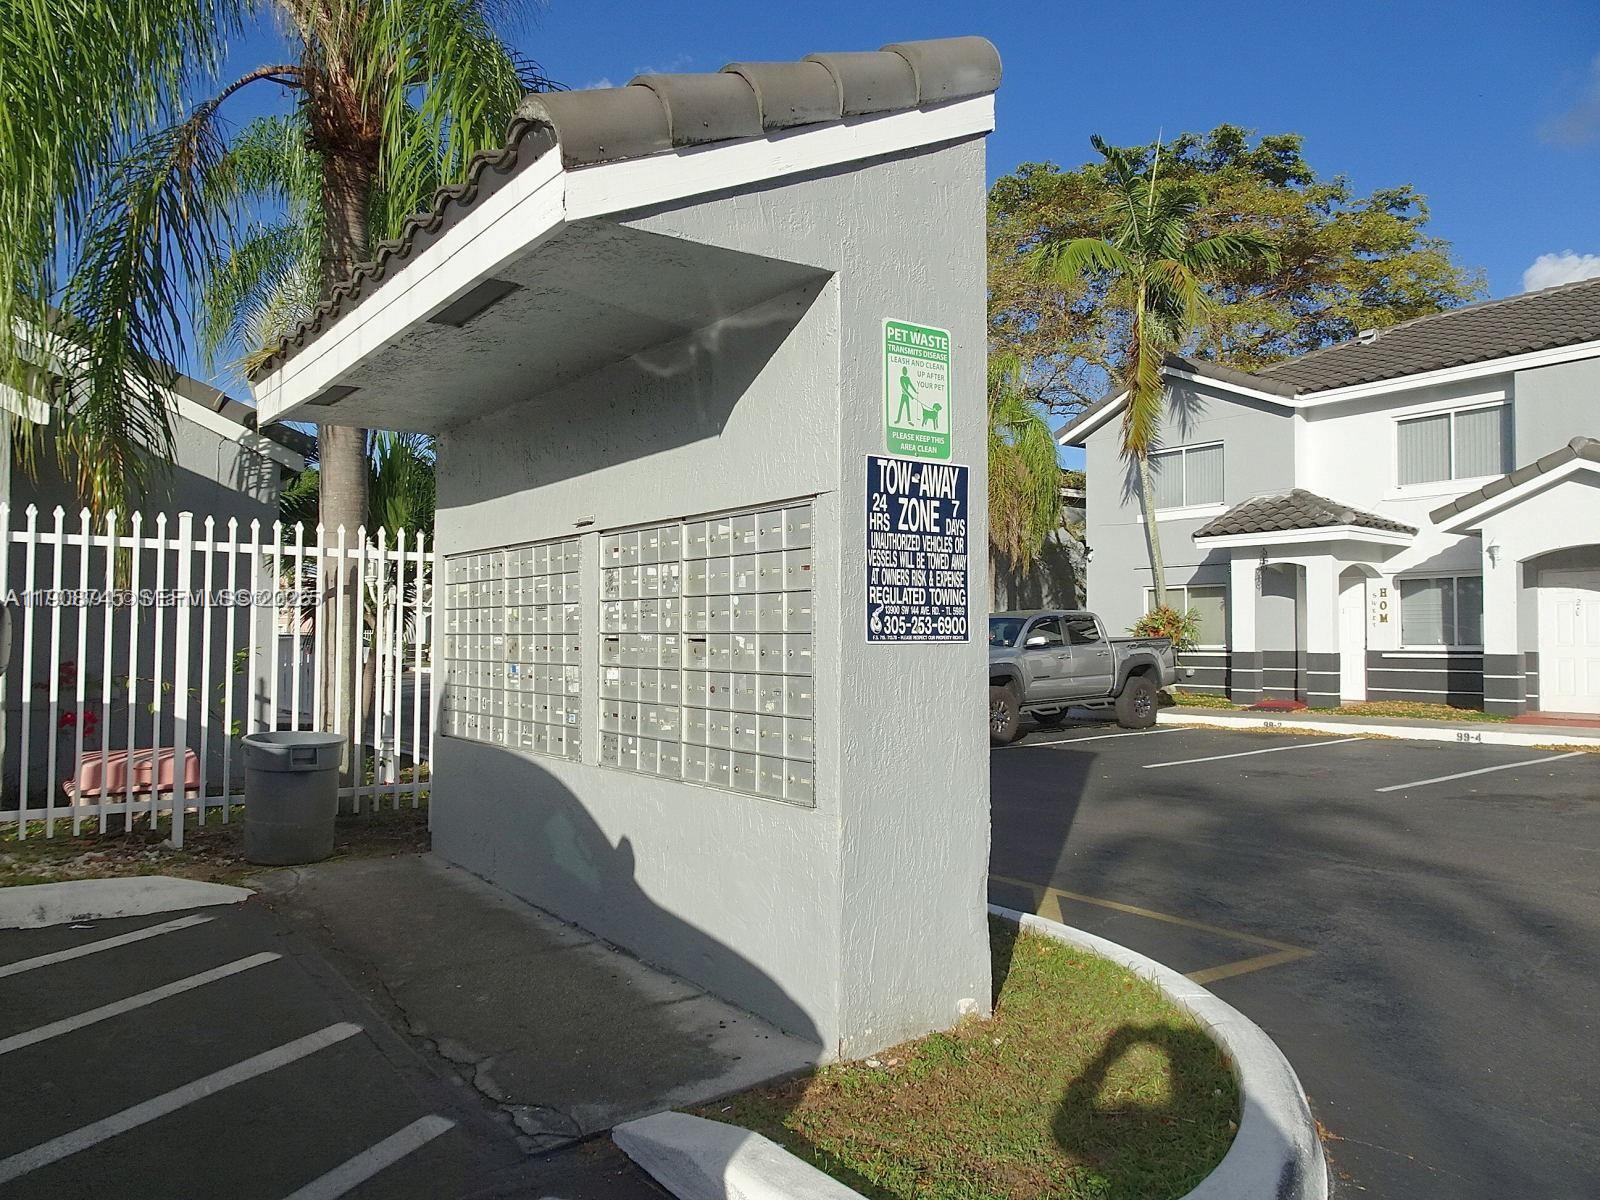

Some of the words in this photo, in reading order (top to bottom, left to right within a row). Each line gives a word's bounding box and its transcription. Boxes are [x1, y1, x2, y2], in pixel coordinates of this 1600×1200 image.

[887, 327, 908, 341] PET
[910, 331, 948, 349] WASTE
[888, 344, 922, 357] TRANSMITS
[924, 351, 948, 361] DISEASE
[890, 356, 910, 366] LEASH
[911, 359, 925, 368] AND
[926, 362, 945, 371] CLEAN
[916, 380, 934, 389] YOUR
[926, 372, 945, 381] AFTER
[892, 431, 915, 441] PLEASE
[916, 435, 931, 443] KEEP
[931, 436, 945, 444] THIS
[900, 443, 916, 452] AREA
[917, 445, 937, 454] CLEAN
[877, 458, 959, 500] TOW-AWAY
[872, 492, 888, 512] 24
[951, 500, 960, 518] 7
[869, 512, 891, 532] HRS
[898, 497, 940, 533] ZONE
[945, 518, 966, 537] DAYS
[870, 531, 920, 551] UNAUTHORIZED
[922, 535, 953, 554] VEHICLES
[954, 537, 964, 554] OR
[868, 549, 897, 567] VESSELS
[899, 551, 915, 568] WILL
[916, 552, 926, 569] BE
[927, 553, 949, 570] TOWED
[951, 554, 967, 571] AWAY
[871, 567, 880, 585] AT
[881, 568, 910, 587] OWNERS
[911, 569, 927, 587] RISK
[928, 570, 934, 587] &
[936, 570, 965, 588] EXPENSE
[869, 586, 926, 605] REGULATED
[929, 587, 966, 606] TOWING
[1379, 587, 1388, 623] HOM
[901, 605, 910, 615] SW
[883, 615, 966, 635] 305-253-6900
[1456, 732, 1482, 742] 99-4
